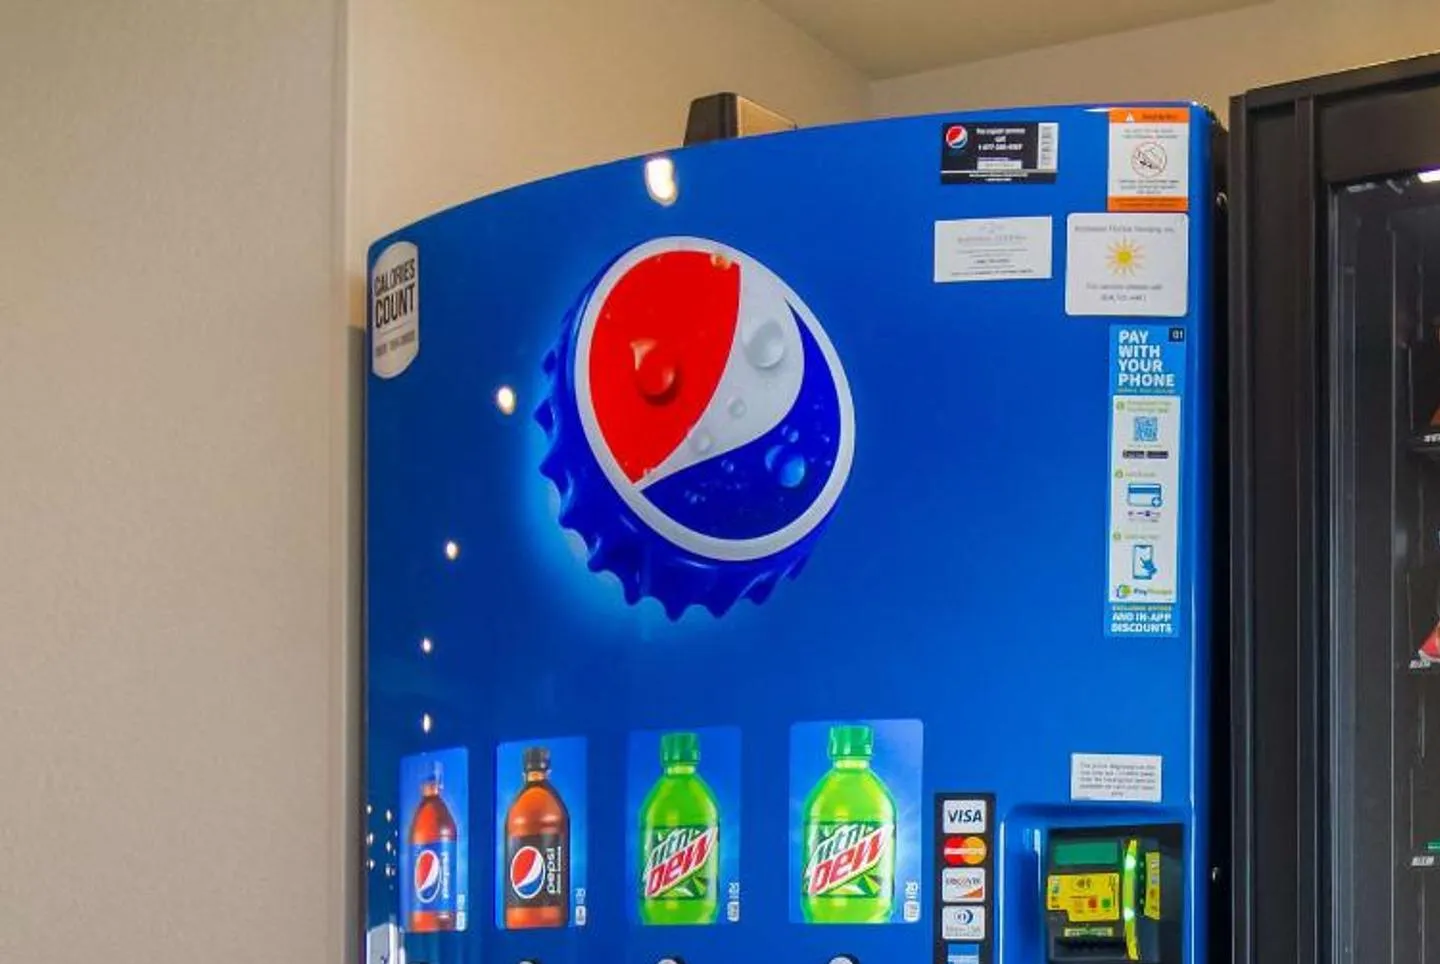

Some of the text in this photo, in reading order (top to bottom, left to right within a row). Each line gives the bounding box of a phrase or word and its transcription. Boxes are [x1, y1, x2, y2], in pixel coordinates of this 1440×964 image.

[375, 258, 416, 296] CALORIES
[375, 284, 416, 329] COUNT
[1118, 329, 1149, 344] PAY
[1118, 345, 1161, 358] WITH
[1118, 359, 1163, 372] YOUR
[1118, 374, 1175, 387] PHONE
[1111, 623, 1172, 633] DISCOUNTS
[949, 809, 983, 823] VISA
[547, 848, 555, 894] pepsi
